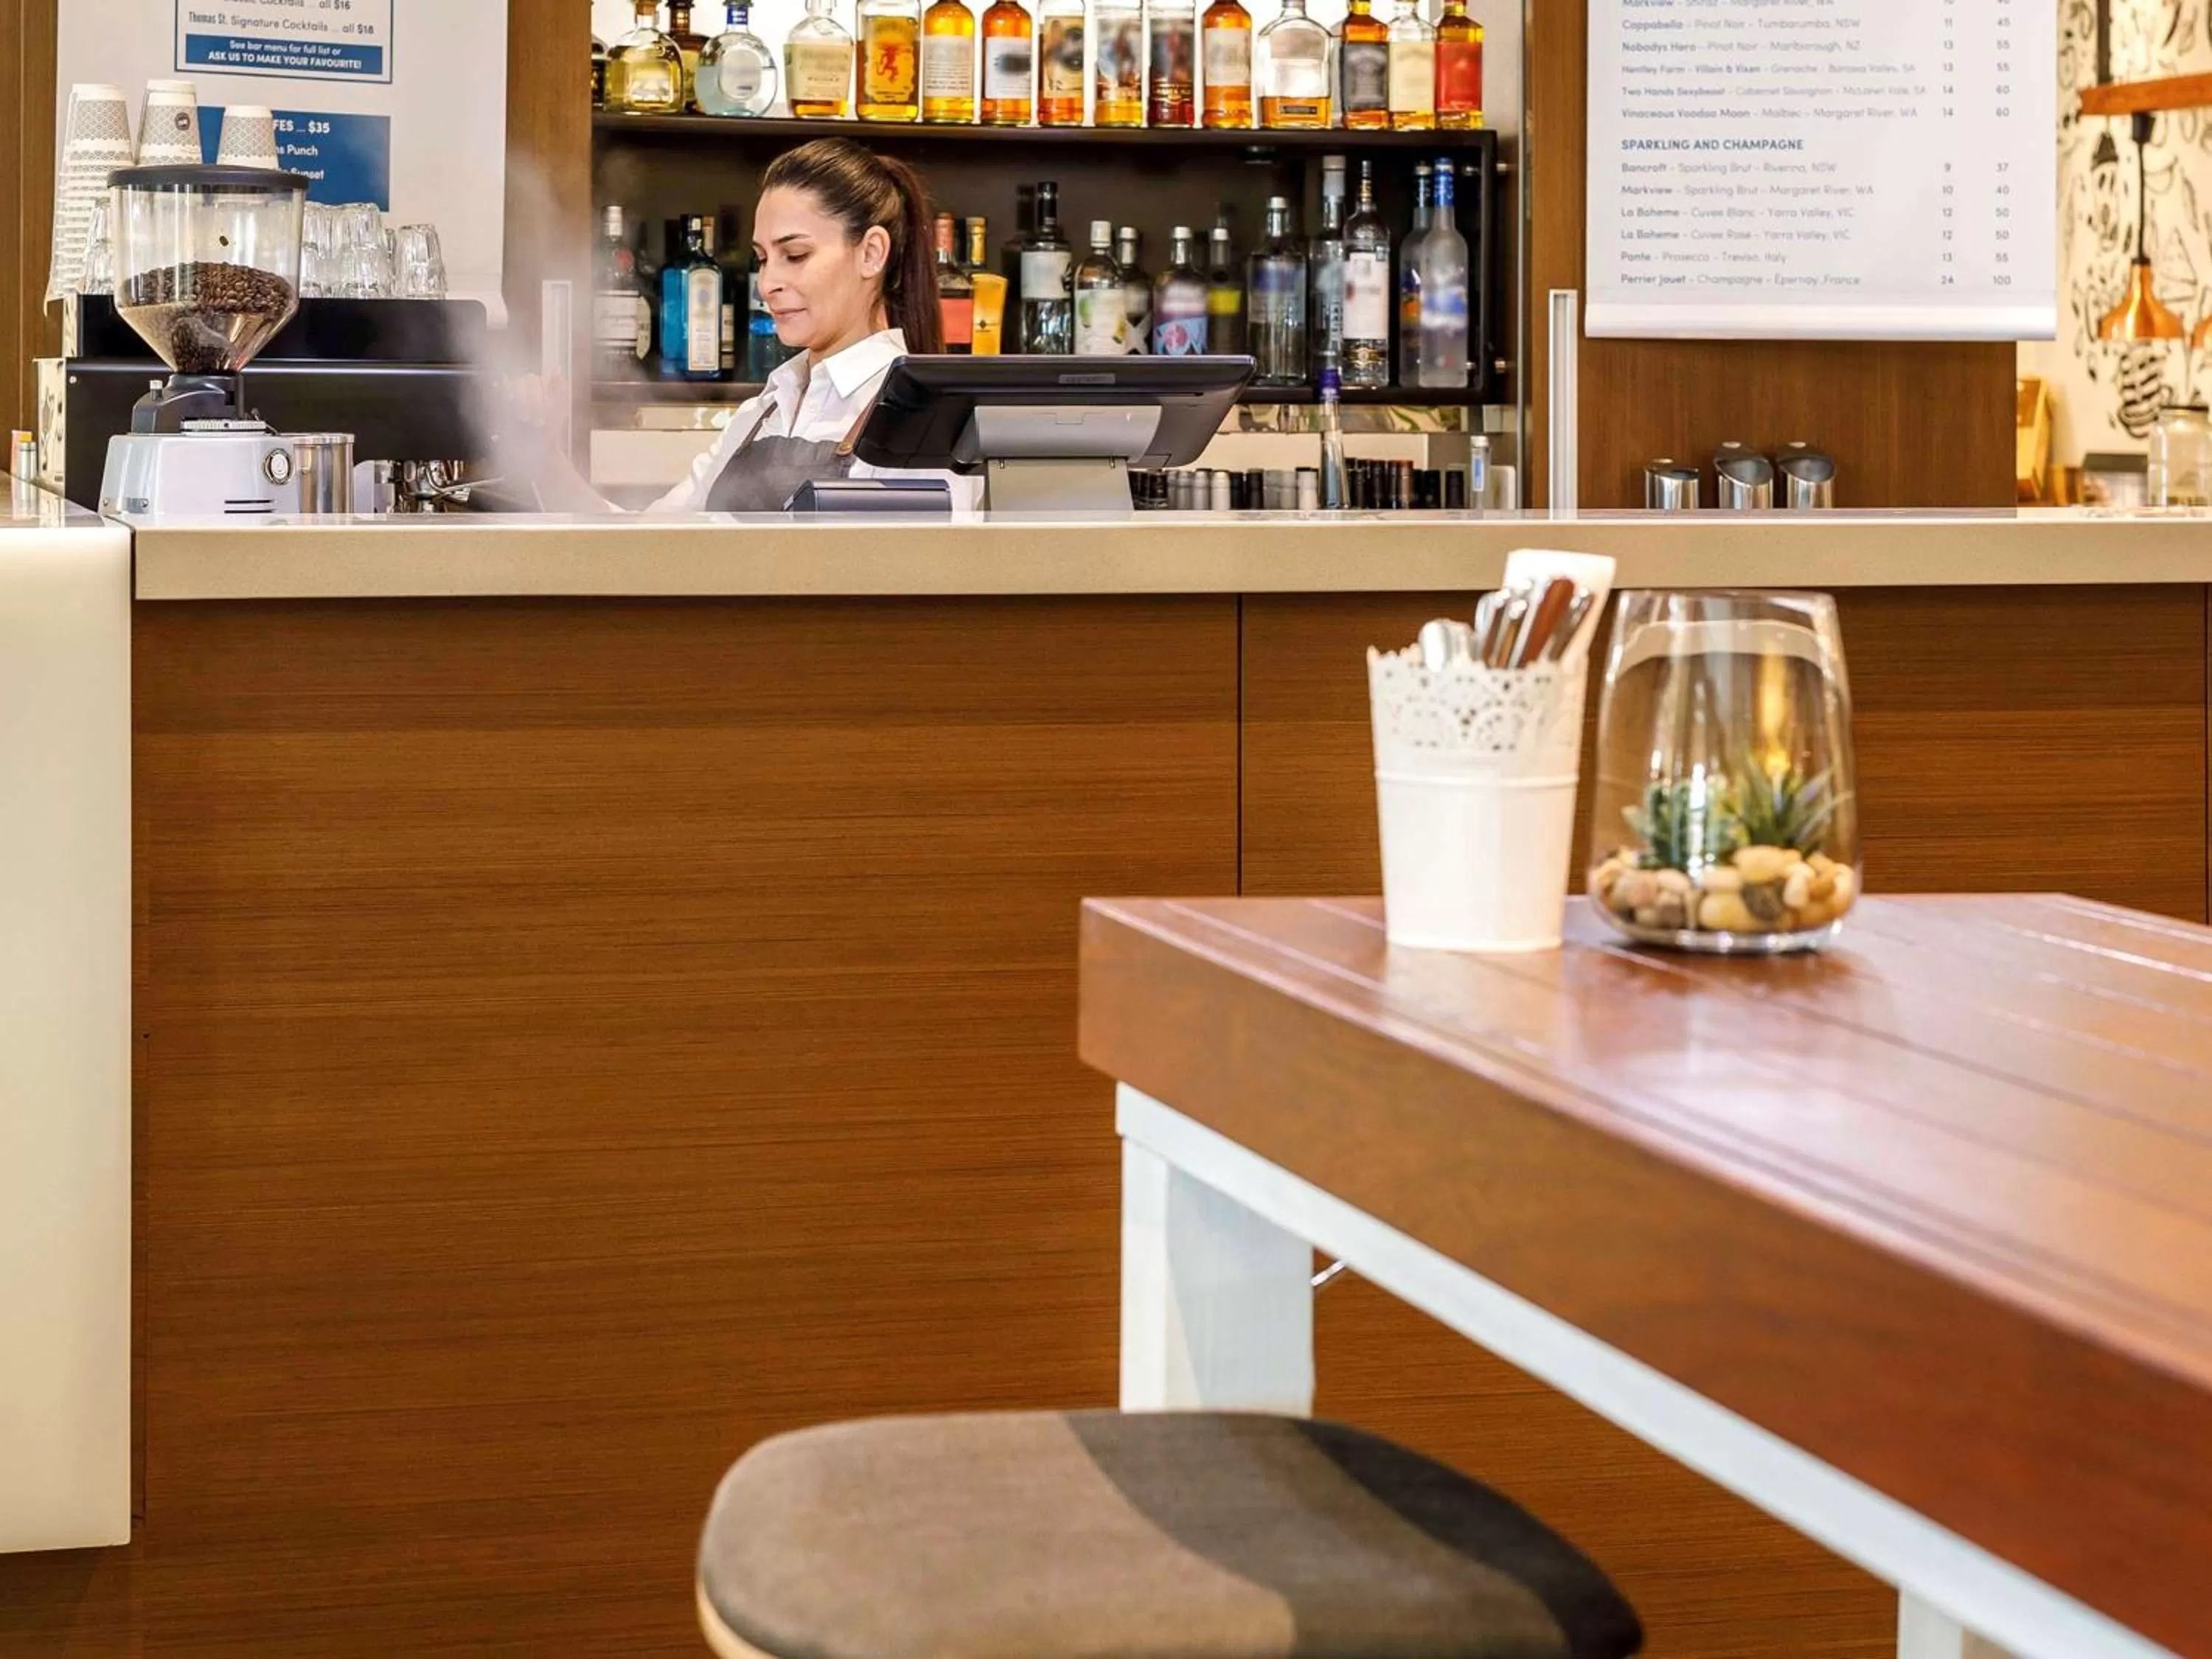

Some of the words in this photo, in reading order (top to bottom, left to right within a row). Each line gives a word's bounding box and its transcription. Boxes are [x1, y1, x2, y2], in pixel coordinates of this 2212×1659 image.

[189, 12, 216, 24] Thomas
[231, 15, 279, 29] Signature
[282, 19, 328, 32] Cocktails
[342, 24, 355, 33] all
[229, 40, 245, 50] See
[248, 41, 262, 52] bar
[264, 44, 288, 53] menu
[289, 44, 301, 55] for
[303, 44, 316, 55] full
[318, 46, 330, 55] list
[332, 48, 341, 56] or
[208, 50, 226, 61] ASK
[229, 52, 240, 62] US
[243, 52, 254, 63] TO
[257, 54, 282, 65] MAKE
[283, 55, 309, 66] YOUR
[310, 57, 362, 69] FAVOURITE!
[308, 119, 330, 134] $35
[287, 144, 319, 156] Punch
[1621, 139, 1690, 150] SPARKLING
[1692, 139, 1719, 150] AND
[1722, 139, 1804, 150] CHAMPAGNE
[1944, 162, 1951, 172] 9
[1996, 162, 2009, 173] 37
[1942, 185, 1954, 195] 10
[1996, 184, 2010, 195] 40
[1943, 207, 1953, 218] 12
[1942, 229, 1953, 240] 12
[1995, 229, 2010, 240] 50
[1996, 252, 2009, 262] 55
[1940, 275, 1954, 285] 24
[1993, 275, 2012, 285] 100
